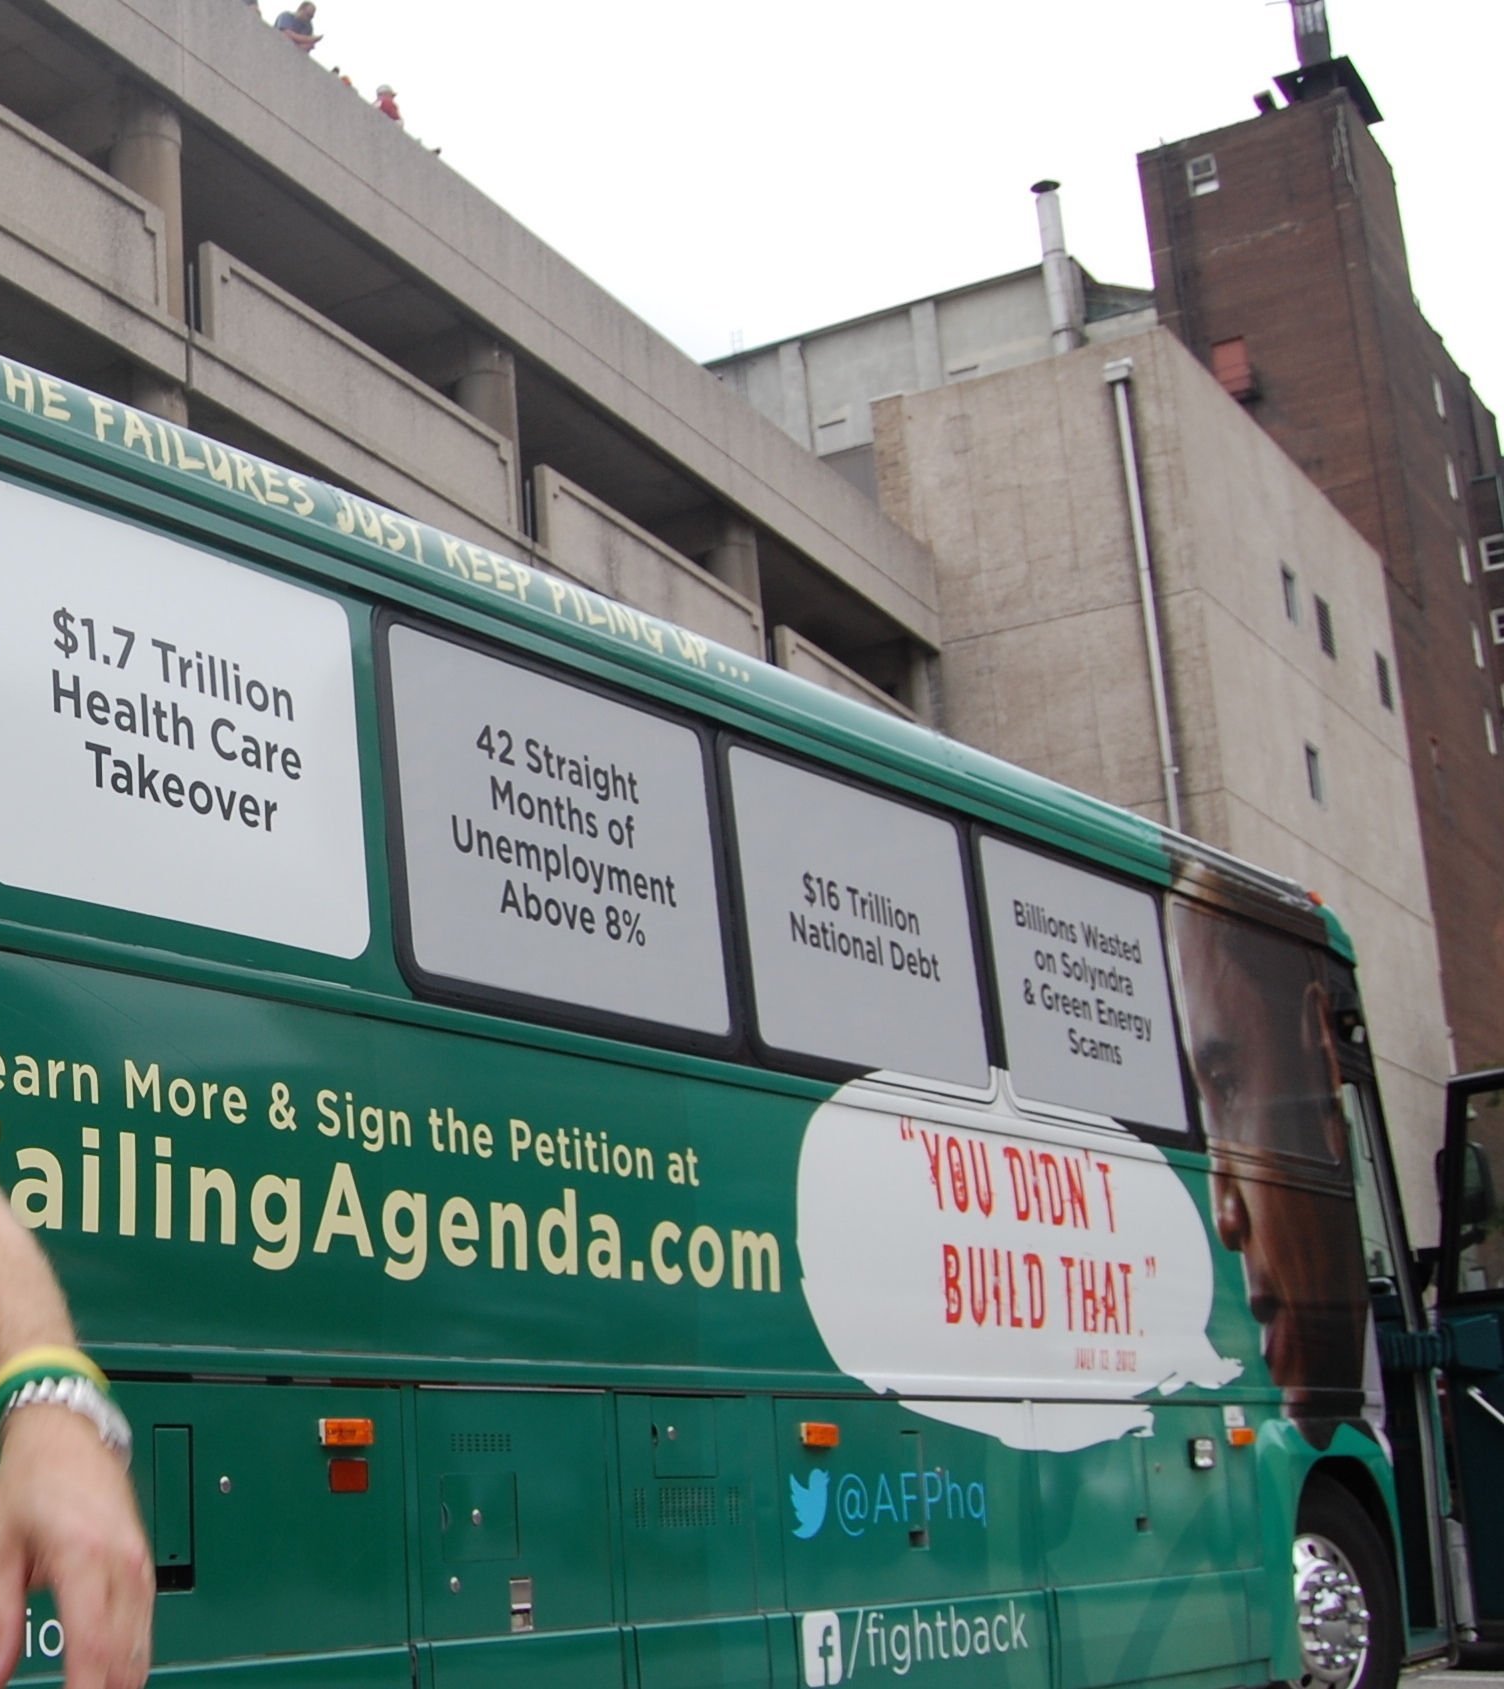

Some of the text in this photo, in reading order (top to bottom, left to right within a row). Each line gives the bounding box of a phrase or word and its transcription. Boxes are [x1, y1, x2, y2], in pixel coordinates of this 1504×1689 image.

[88, 396, 316, 517] FAILURES
[335, 494, 425, 564] JUST
[440, 534, 531, 601] KEEP
[545, 576, 663, 654] PILING
[53, 606, 295, 722] $1.7 Trillion
[52, 669, 302, 781] Health Care
[85, 741, 278, 832] Takeover
[476, 725, 640, 805] 42 Straight
[490, 775, 635, 849] Months of
[451, 814, 677, 908] Unemployment
[500, 879, 646, 947] Above 8%
[802, 871, 921, 936] $16 Trillion
[1013, 899, 1143, 965] Billions Wasted
[790, 911, 941, 983] National Debt
[1034, 949, 1135, 997] on Solyndra
[1023, 977, 1153, 1042] & Green Energy
[1067, 1027, 1123, 1066] Scams
[124, 1059, 248, 1125] More
[268, 1081, 297, 1132] &
[316, 1089, 412, 1153] Sign
[428, 1107, 494, 1159] the
[509, 1119, 655, 1181] Petition
[667, 1147, 700, 1187] at
[1002, 1146, 1116, 1234] DIDN'T
[943, 1243, 1046, 1329] BUILD
[836, 1470, 987, 1537] @AFPhq
